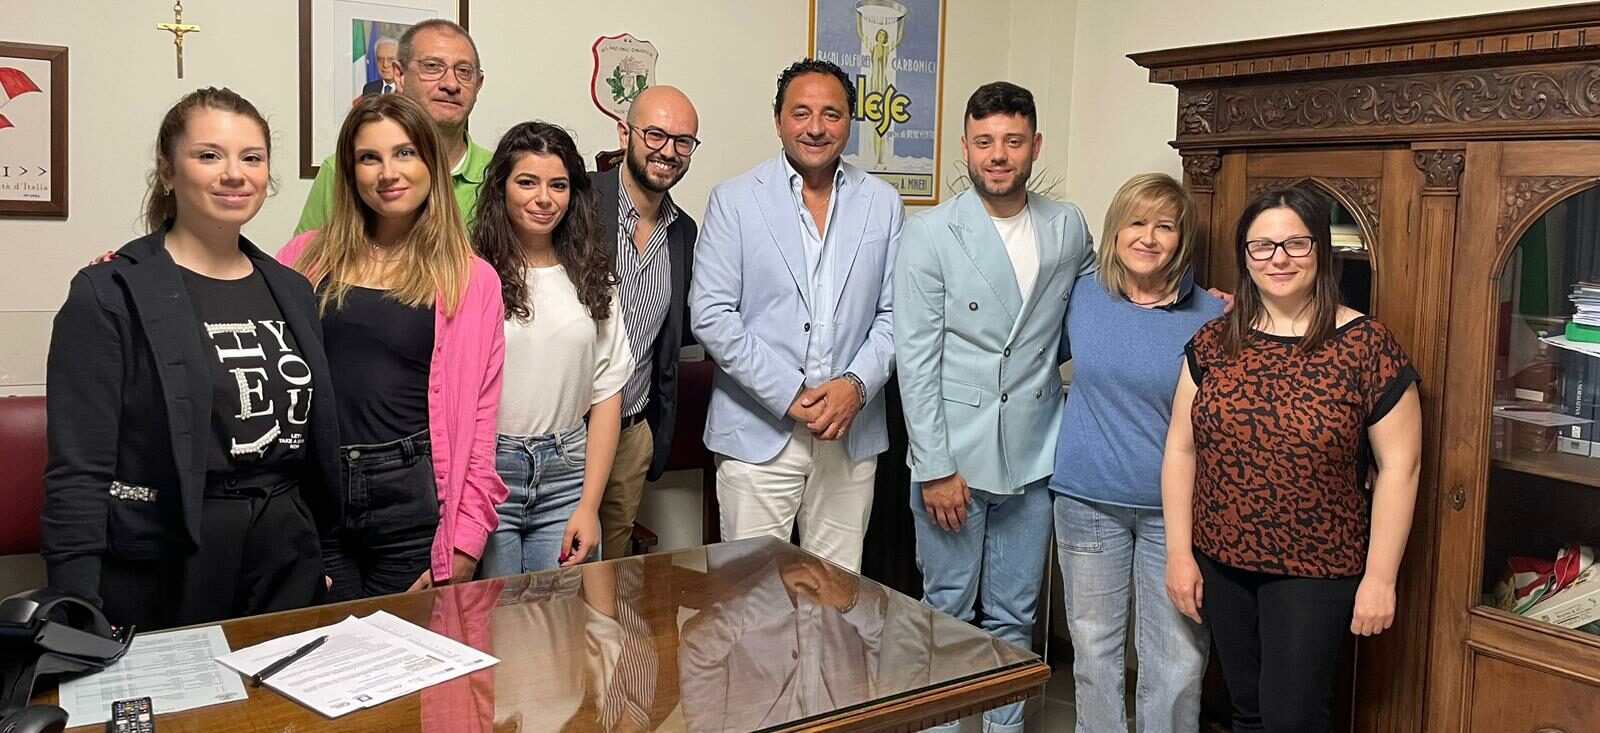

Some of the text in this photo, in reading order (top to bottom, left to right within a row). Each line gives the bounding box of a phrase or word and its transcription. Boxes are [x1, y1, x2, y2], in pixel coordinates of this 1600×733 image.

[892, 58, 936, 73] CARBONICI
[852, 74, 912, 138] lese
[14, 182, 48, 191] d'Italia
[257, 320, 313, 425] YOU
